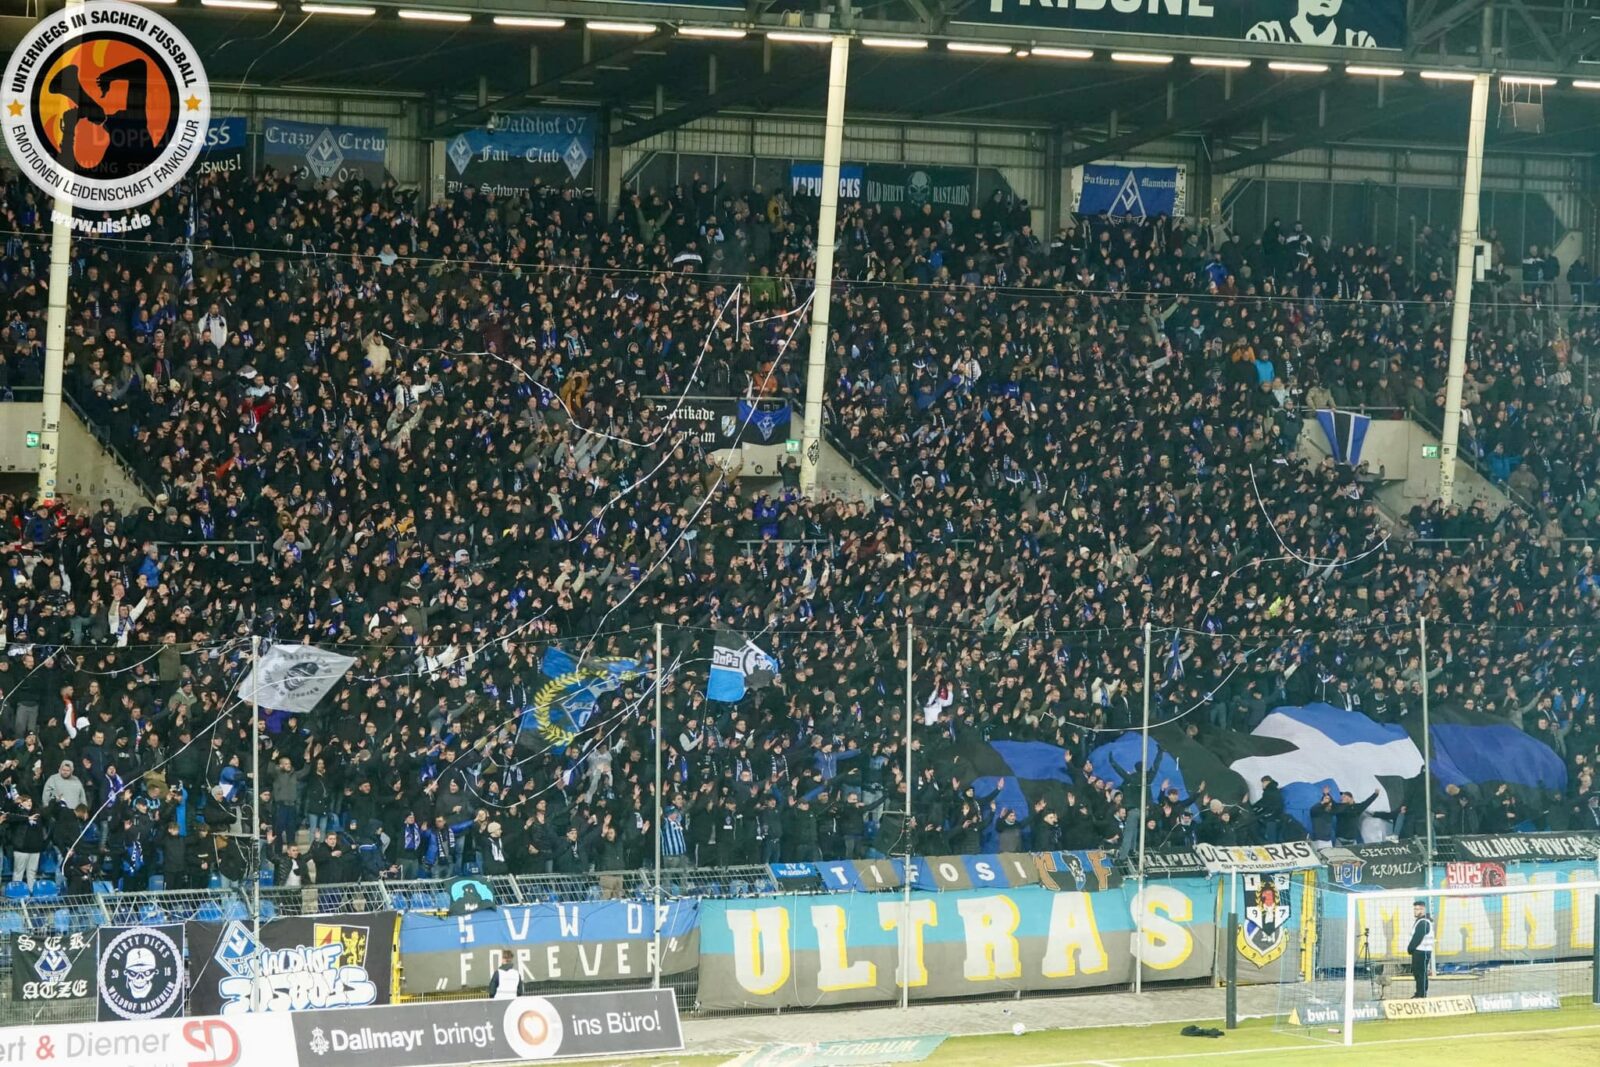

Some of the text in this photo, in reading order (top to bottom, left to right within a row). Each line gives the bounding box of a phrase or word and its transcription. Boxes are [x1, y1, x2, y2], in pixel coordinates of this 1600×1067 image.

[265, 127, 386, 151] Crazy Crew
[478, 145, 509, 163] Fan
[525, 147, 559, 163] Club
[866, 180, 881, 202] OLD
[882, 183, 905, 202] DIRTY
[113, 936, 170, 960] DIRTY DICKS
[726, 885, 1193, 995] ULTRAS
[108, 981, 175, 1011] WALDHOF MANNHEIM
[1388, 998, 1473, 1017] SPORTWETTEN
[1482, 995, 1513, 1010] bwin
[1307, 1004, 1338, 1022] bwin
[331, 1010, 661, 1052] Dallmayr bringt ins Büro!
[36, 1035, 55, 1060] &
[67, 1032, 170, 1058] Diemer
